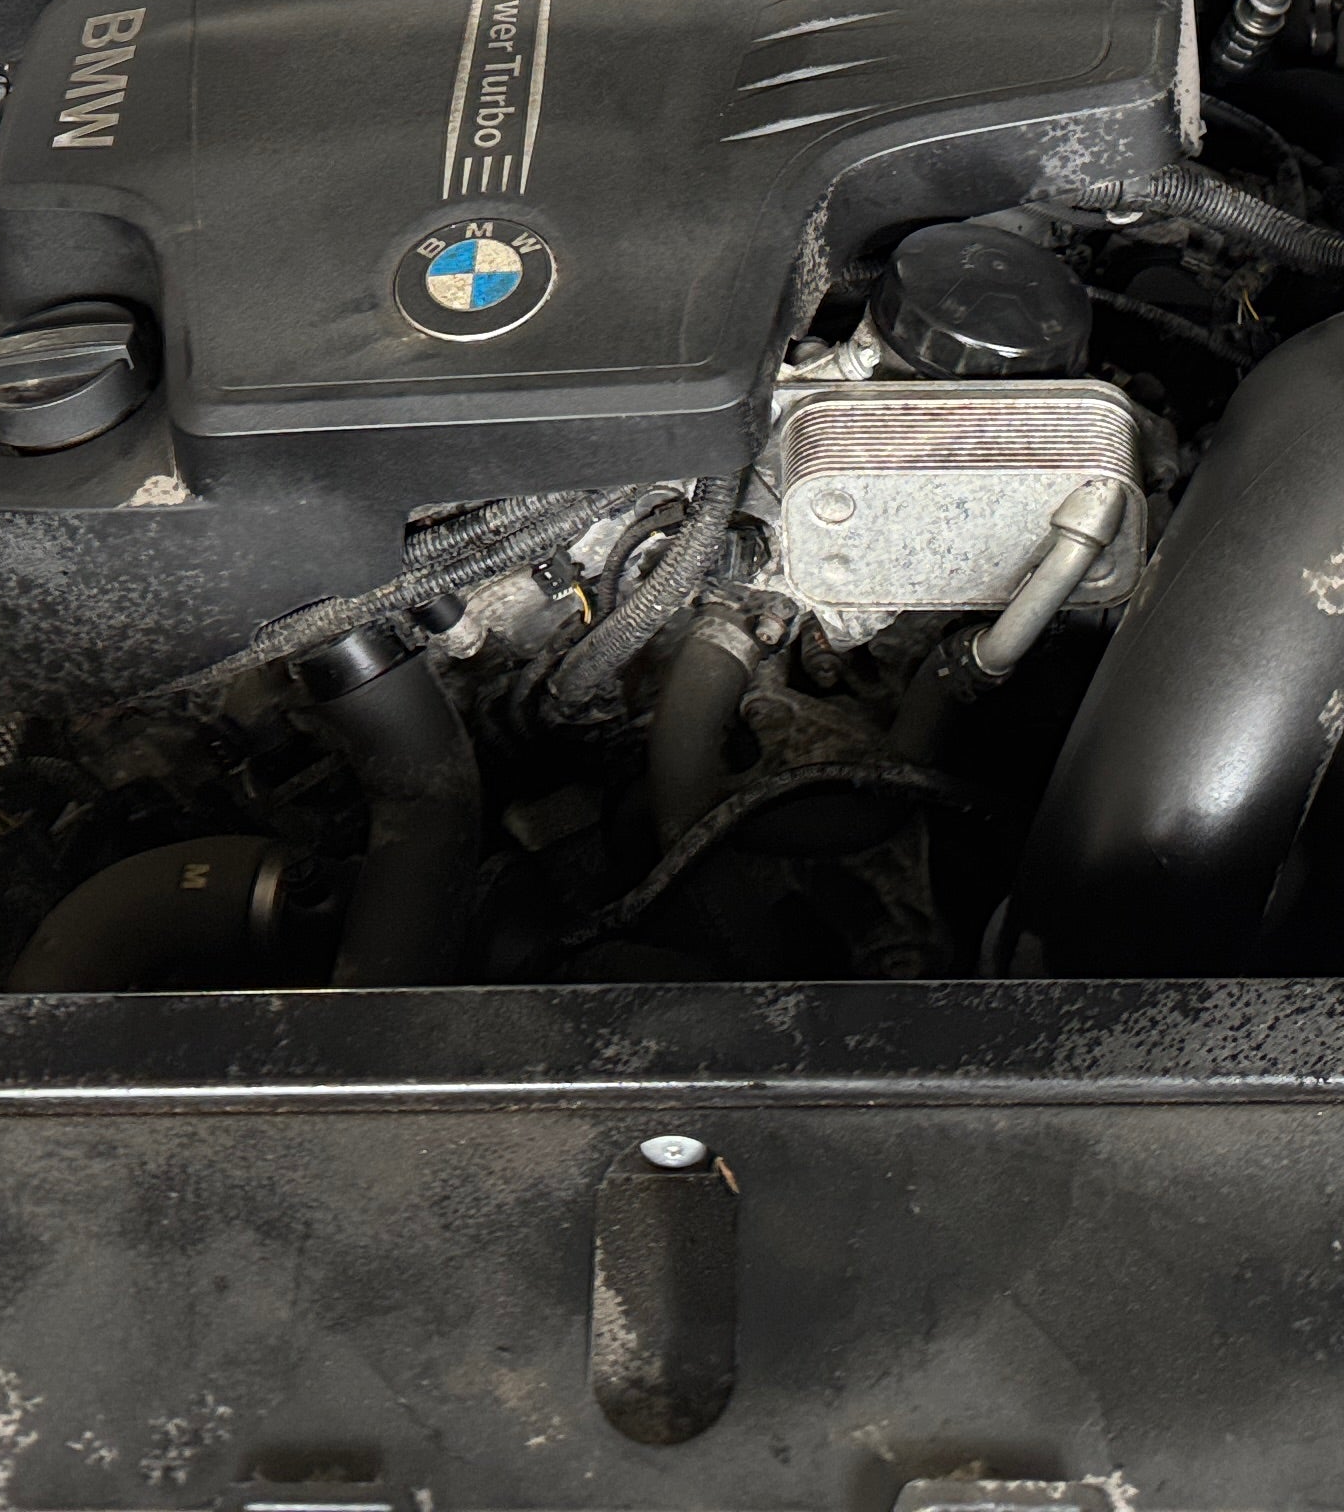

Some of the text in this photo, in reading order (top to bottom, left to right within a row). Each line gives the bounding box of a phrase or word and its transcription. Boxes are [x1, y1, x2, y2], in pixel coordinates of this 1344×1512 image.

[52, 7, 147, 148] BMW
[473, 54, 523, 149] Turbo
[416, 221, 543, 259] BMW
